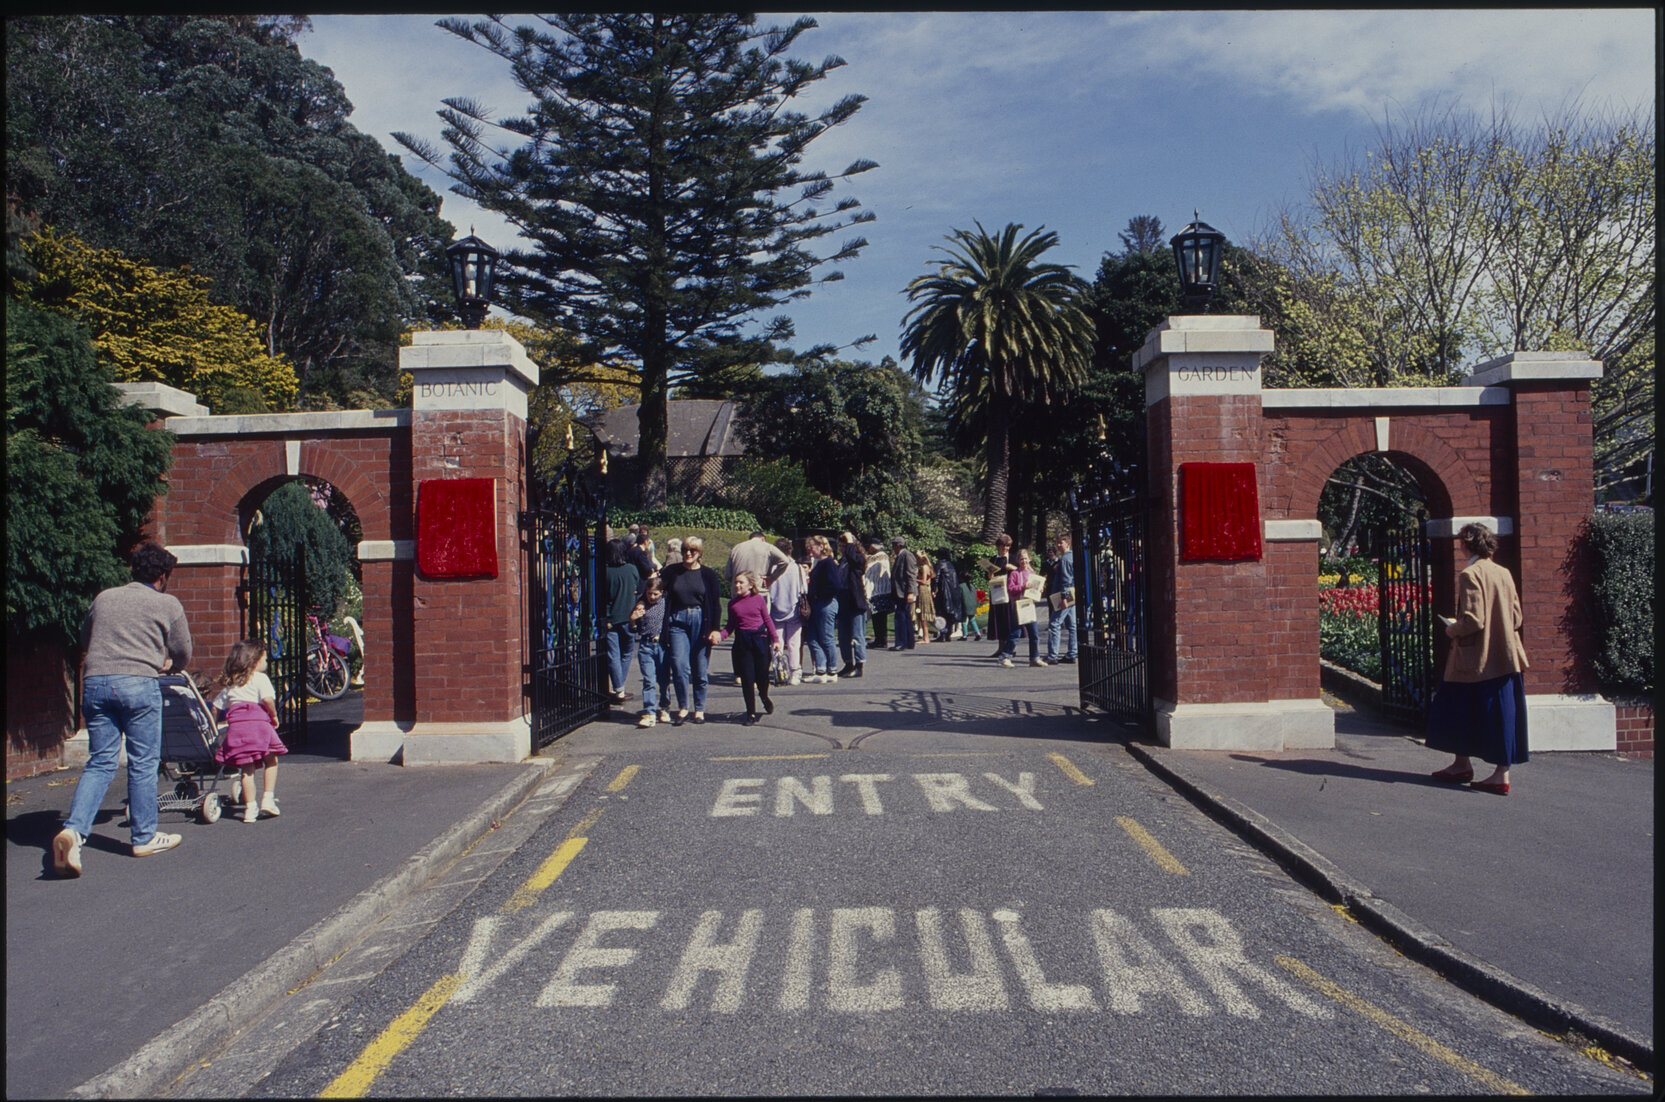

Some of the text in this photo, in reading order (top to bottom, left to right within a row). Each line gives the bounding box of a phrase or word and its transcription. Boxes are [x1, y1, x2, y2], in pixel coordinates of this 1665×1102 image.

[421, 381, 497, 398] BOTANIC
[1177, 365, 1254, 382] GARDEN
[709, 771, 1046, 818] ENTRY
[450, 906, 1336, 1022] VEHICULAR
